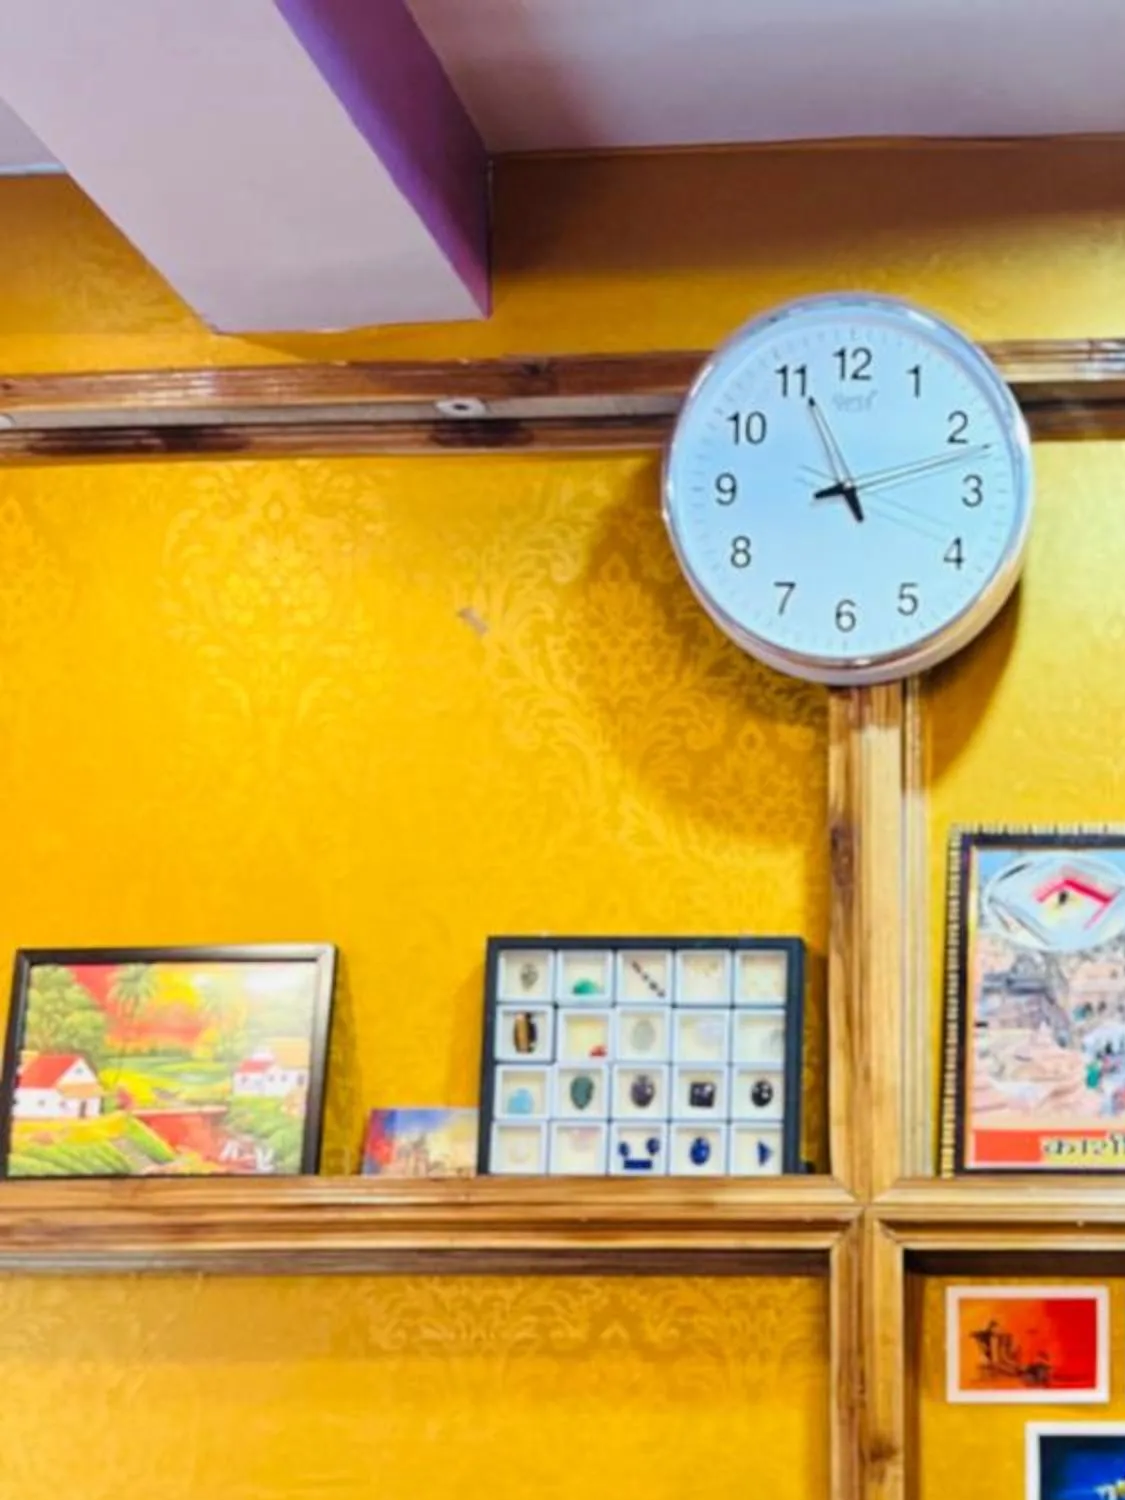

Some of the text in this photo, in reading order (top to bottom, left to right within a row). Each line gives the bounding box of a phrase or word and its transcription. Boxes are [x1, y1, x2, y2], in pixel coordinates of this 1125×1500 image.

[832, 346, 873, 381] 12
[775, 365, 808, 398] 11
[907, 366, 921, 398] 1
[728, 411, 767, 445] 10
[947, 411, 969, 444] 2
[715, 473, 738, 506] 9
[961, 475, 984, 507] 3
[730, 536, 752, 569] 8
[943, 538, 965, 569] 4
[774, 582, 796, 615] 7
[897, 582, 919, 616] 5
[835, 600, 857, 633] 6
